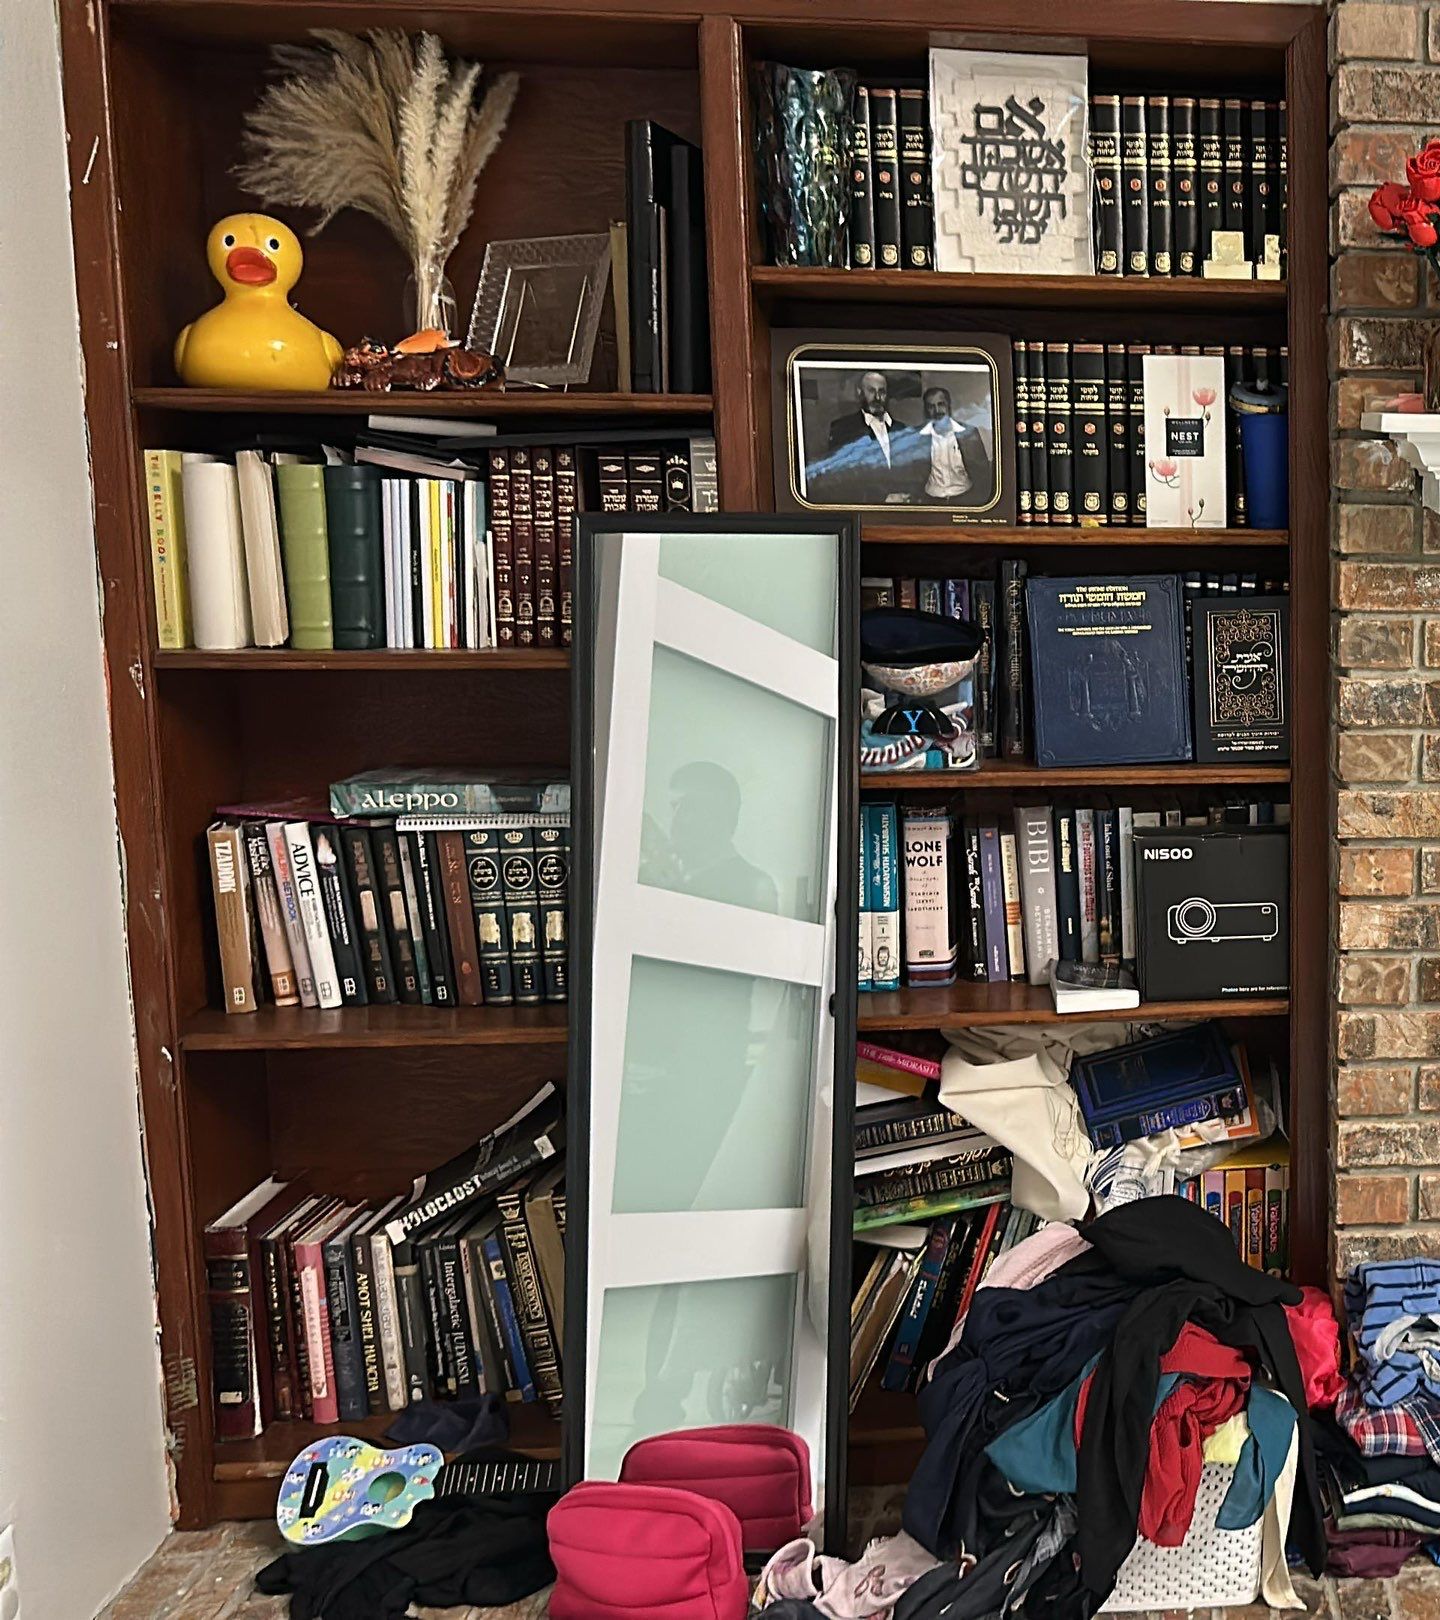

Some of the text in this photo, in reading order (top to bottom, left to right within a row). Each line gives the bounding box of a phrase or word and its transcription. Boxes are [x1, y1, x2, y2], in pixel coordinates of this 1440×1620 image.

[1171, 431, 1199, 441] NEST
[901, 711, 925, 733] Y
[906, 841, 942, 853] LONE
[1027, 821, 1050, 875] BIBI
[1144, 848, 1193, 861] NISOO
[292, 843, 315, 897] ADVICE
[906, 856, 943, 867] WOLF
[356, 1272, 371, 1310] AMOT
[360, 1310, 374, 1343] SHEL
[444, 1261, 470, 1385] Intergalactic JUDAISM
